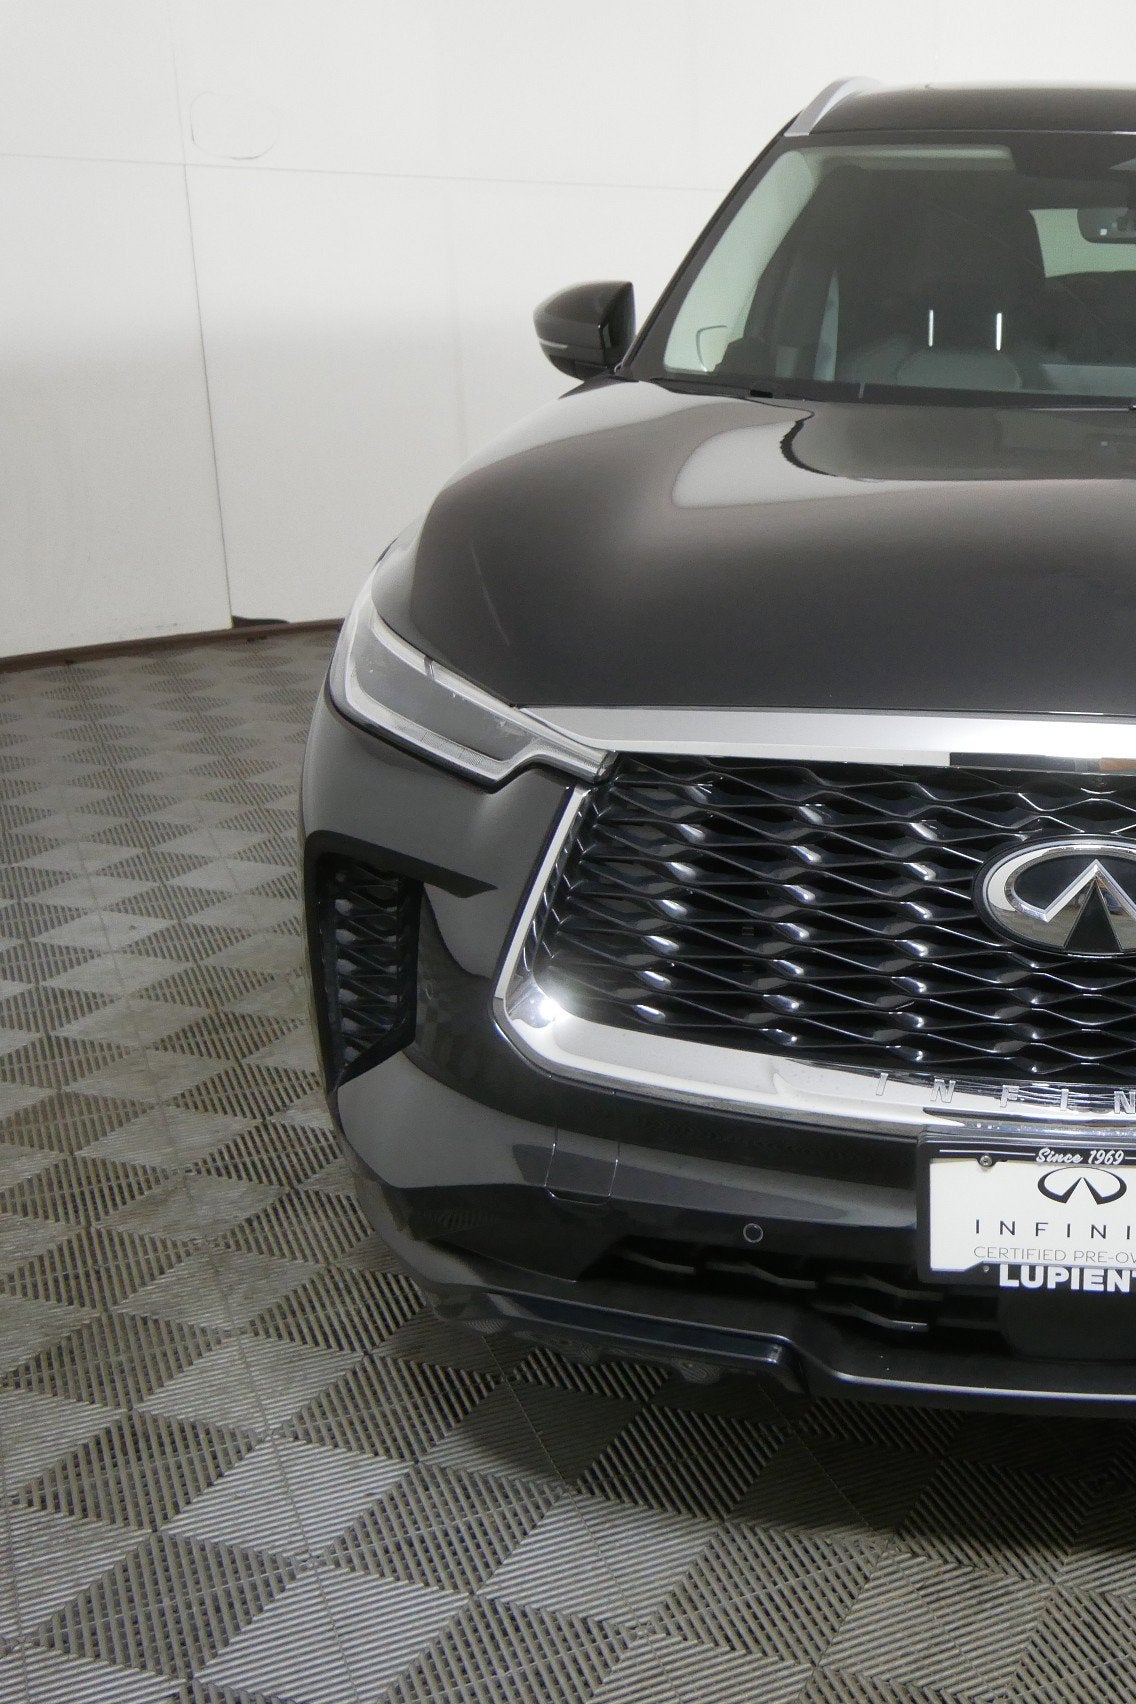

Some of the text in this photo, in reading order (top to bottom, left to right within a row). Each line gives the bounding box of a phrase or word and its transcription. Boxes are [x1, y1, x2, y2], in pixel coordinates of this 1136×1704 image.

[1035, 1147, 1124, 1166] Since 1969
[973, 1246, 1066, 1262] CERTIFIED
